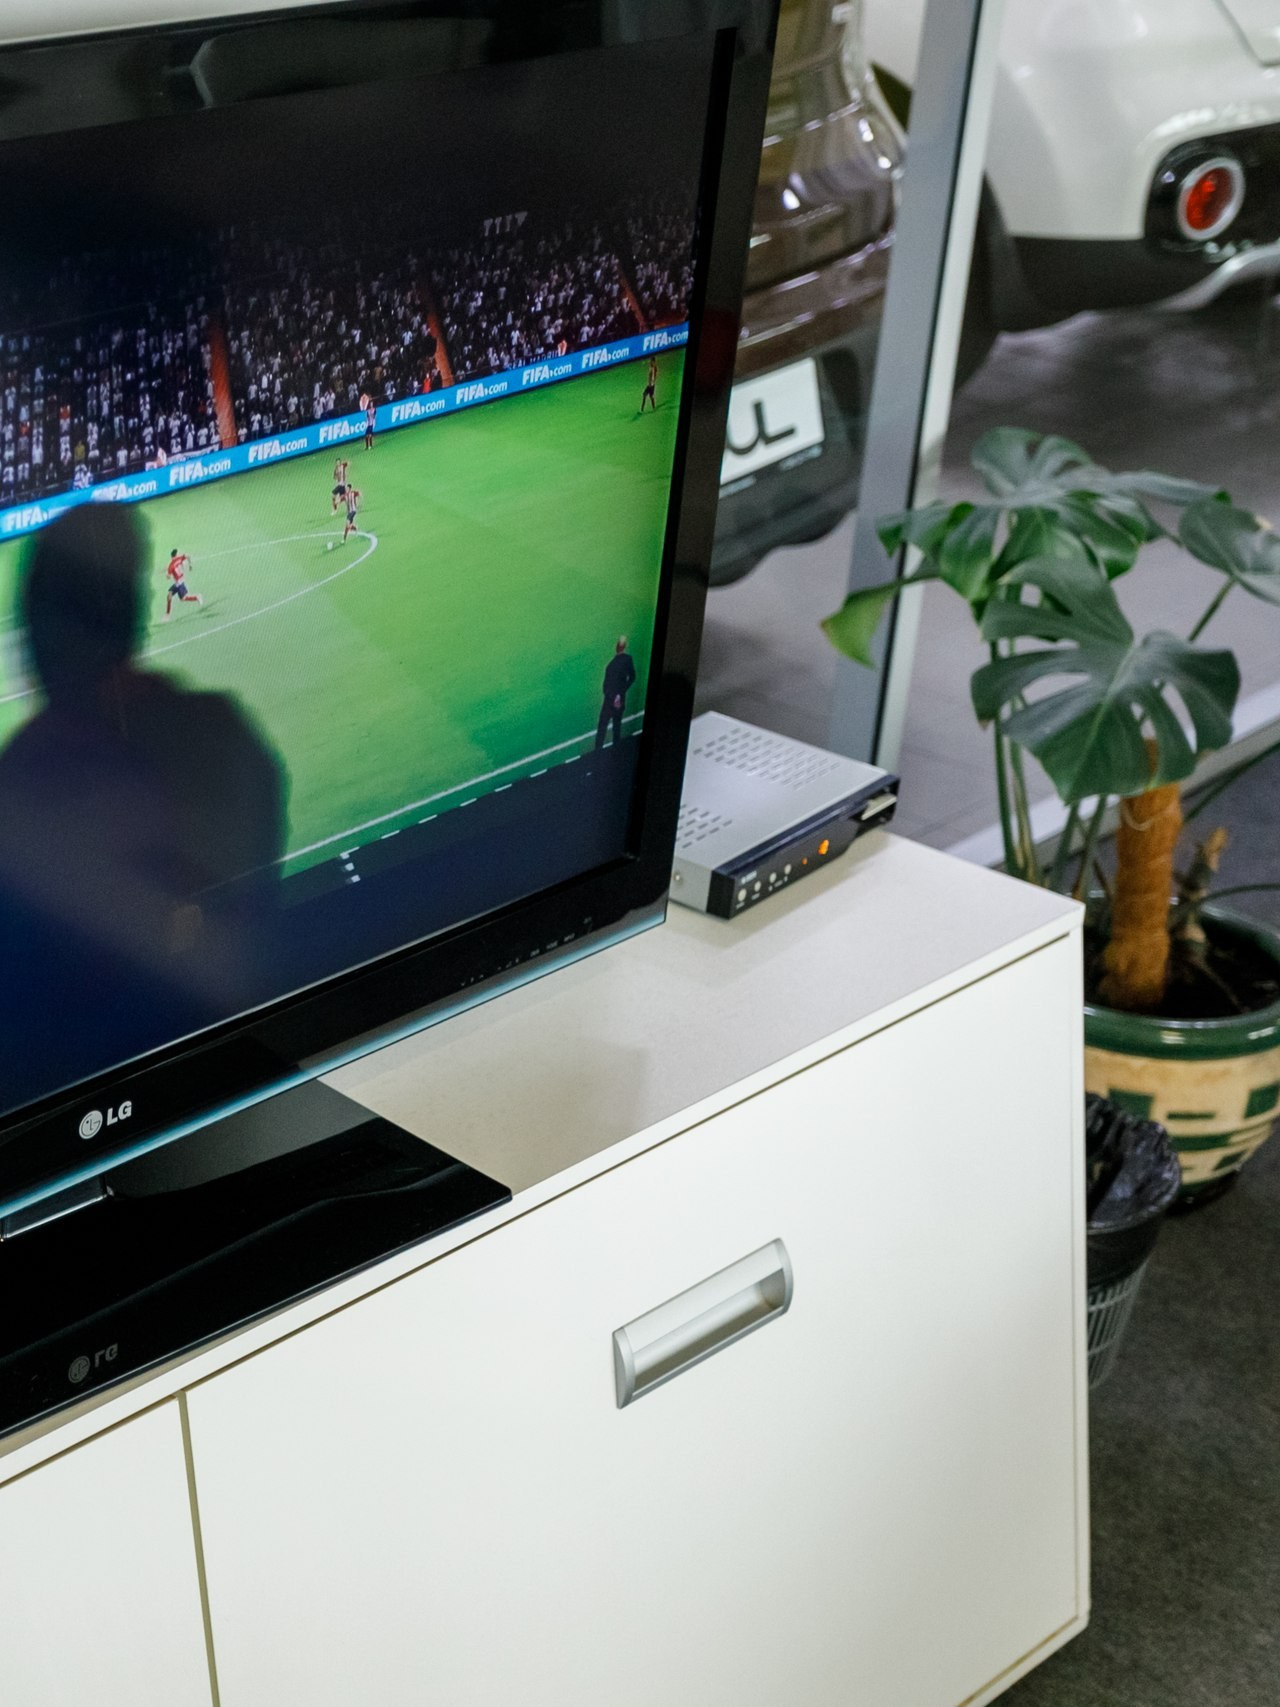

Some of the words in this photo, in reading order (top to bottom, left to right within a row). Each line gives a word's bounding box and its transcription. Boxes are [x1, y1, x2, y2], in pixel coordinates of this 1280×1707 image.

[169, 458, 231, 487] FIFA.com
[248, 436, 308, 464] FIFA.com
[319, 420, 368, 444] FIFA.co
[391, 397, 446, 423] FIFA.com
[456, 379, 508, 405] FIFA.com
[522, 363, 572, 386] FIFA.com
[581, 346, 630, 370] FIFA.com
[106, 1101, 133, 1126] LG
